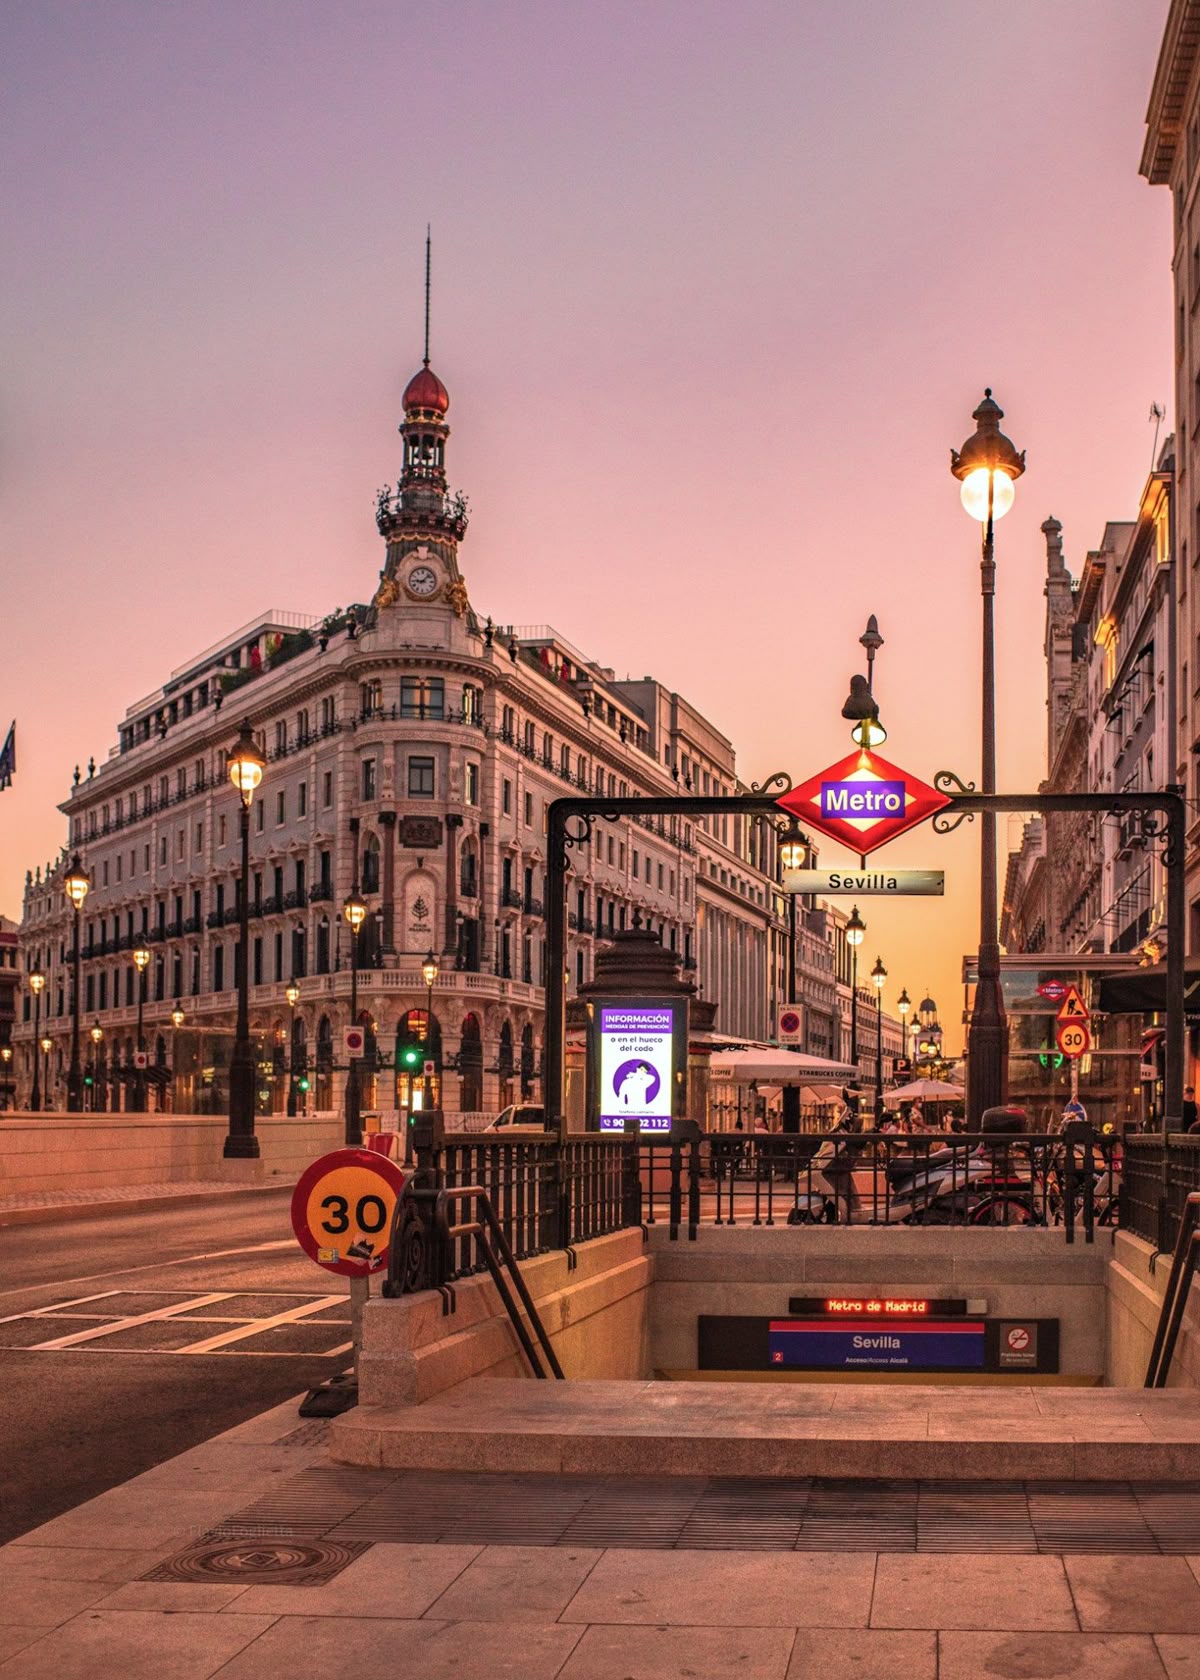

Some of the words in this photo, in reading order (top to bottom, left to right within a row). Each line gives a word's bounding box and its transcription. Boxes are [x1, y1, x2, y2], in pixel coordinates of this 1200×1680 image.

[826, 789, 901, 811] Metro
[829, 873, 897, 889] Sevilla
[605, 1014, 669, 1023] INFORMACIÓN
[1064, 1033, 1083, 1046] 30
[897, 1060, 906, 1070] P
[799, 1069, 834, 1077] STARBUCKS
[651, 1118, 669, 1127] 112
[320, 1194, 387, 1234] 30
[829, 1301, 862, 1311] Metro
[867, 1301, 881, 1311] de
[885, 1301, 926, 1312] Madrid
[852, 1335, 900, 1349] Sevilla
[775, 1352, 781, 1361] 2
